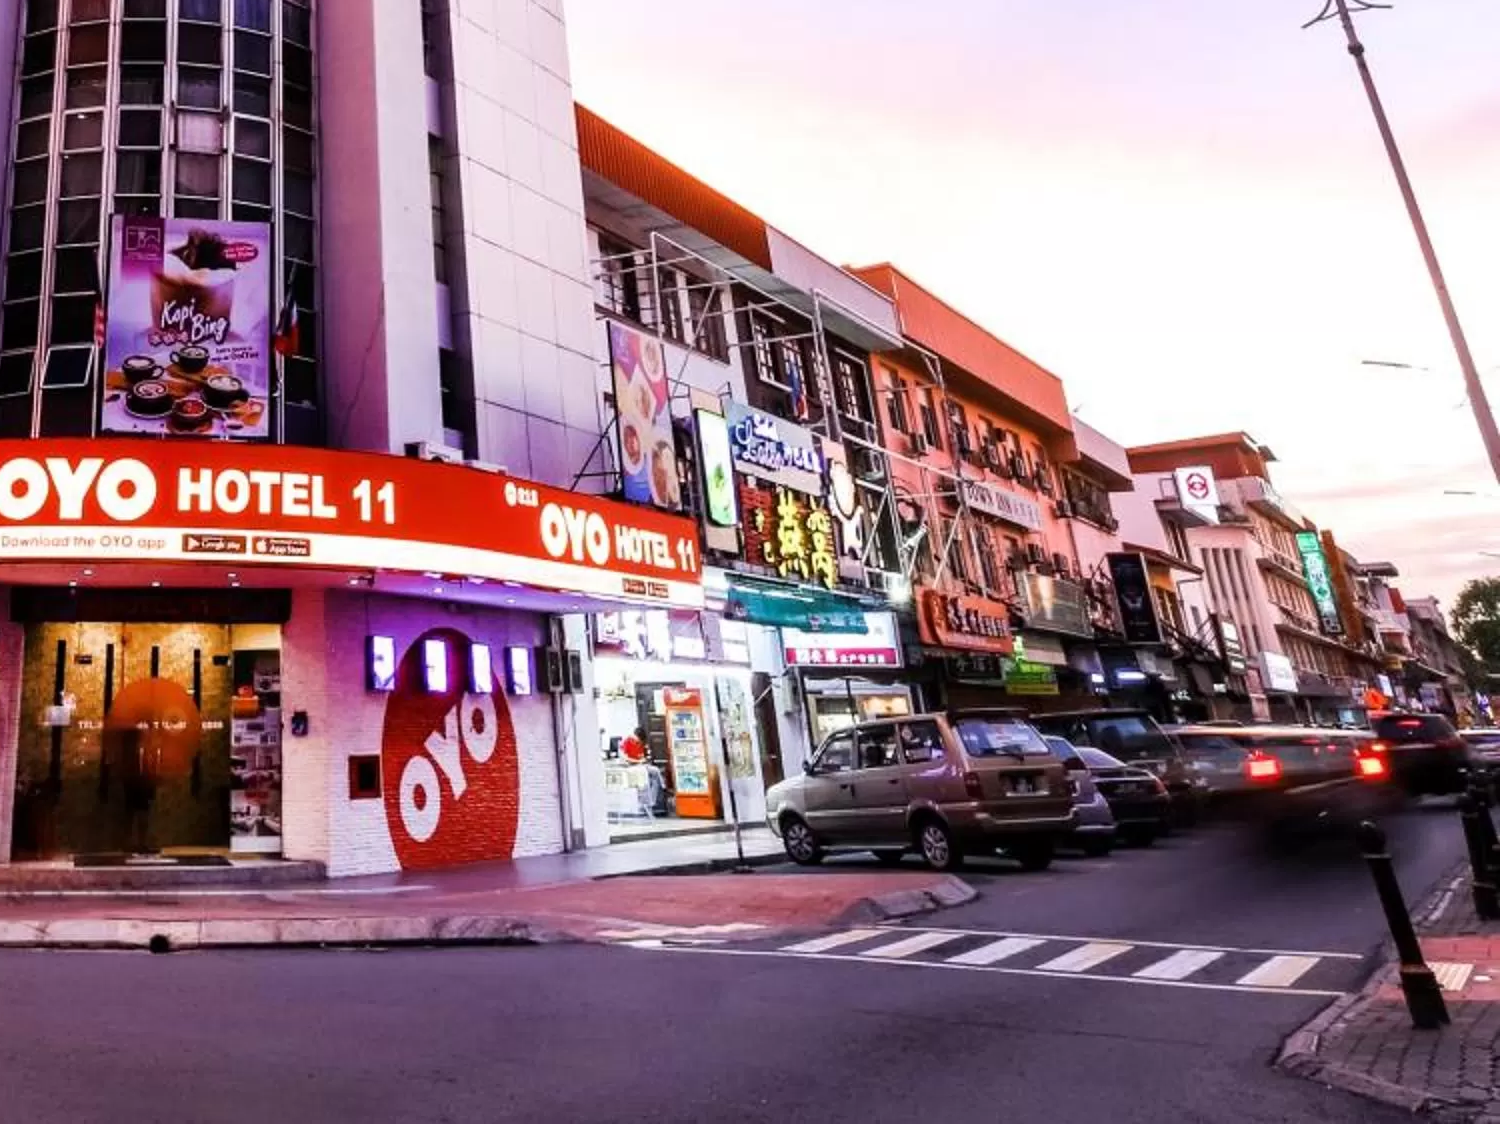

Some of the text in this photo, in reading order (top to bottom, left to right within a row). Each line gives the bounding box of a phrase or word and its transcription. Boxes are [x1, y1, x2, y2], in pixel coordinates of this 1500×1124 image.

[161, 298, 195, 331] Kopi
[191, 313, 228, 344] Bing
[177, 467, 337, 519] HOTEL
[352, 479, 396, 525] 11
[1, 534, 167, 550] Download the OYO app
[540, 502, 697, 573] OYO HOTEL 11
[400, 691, 499, 843] OYO
